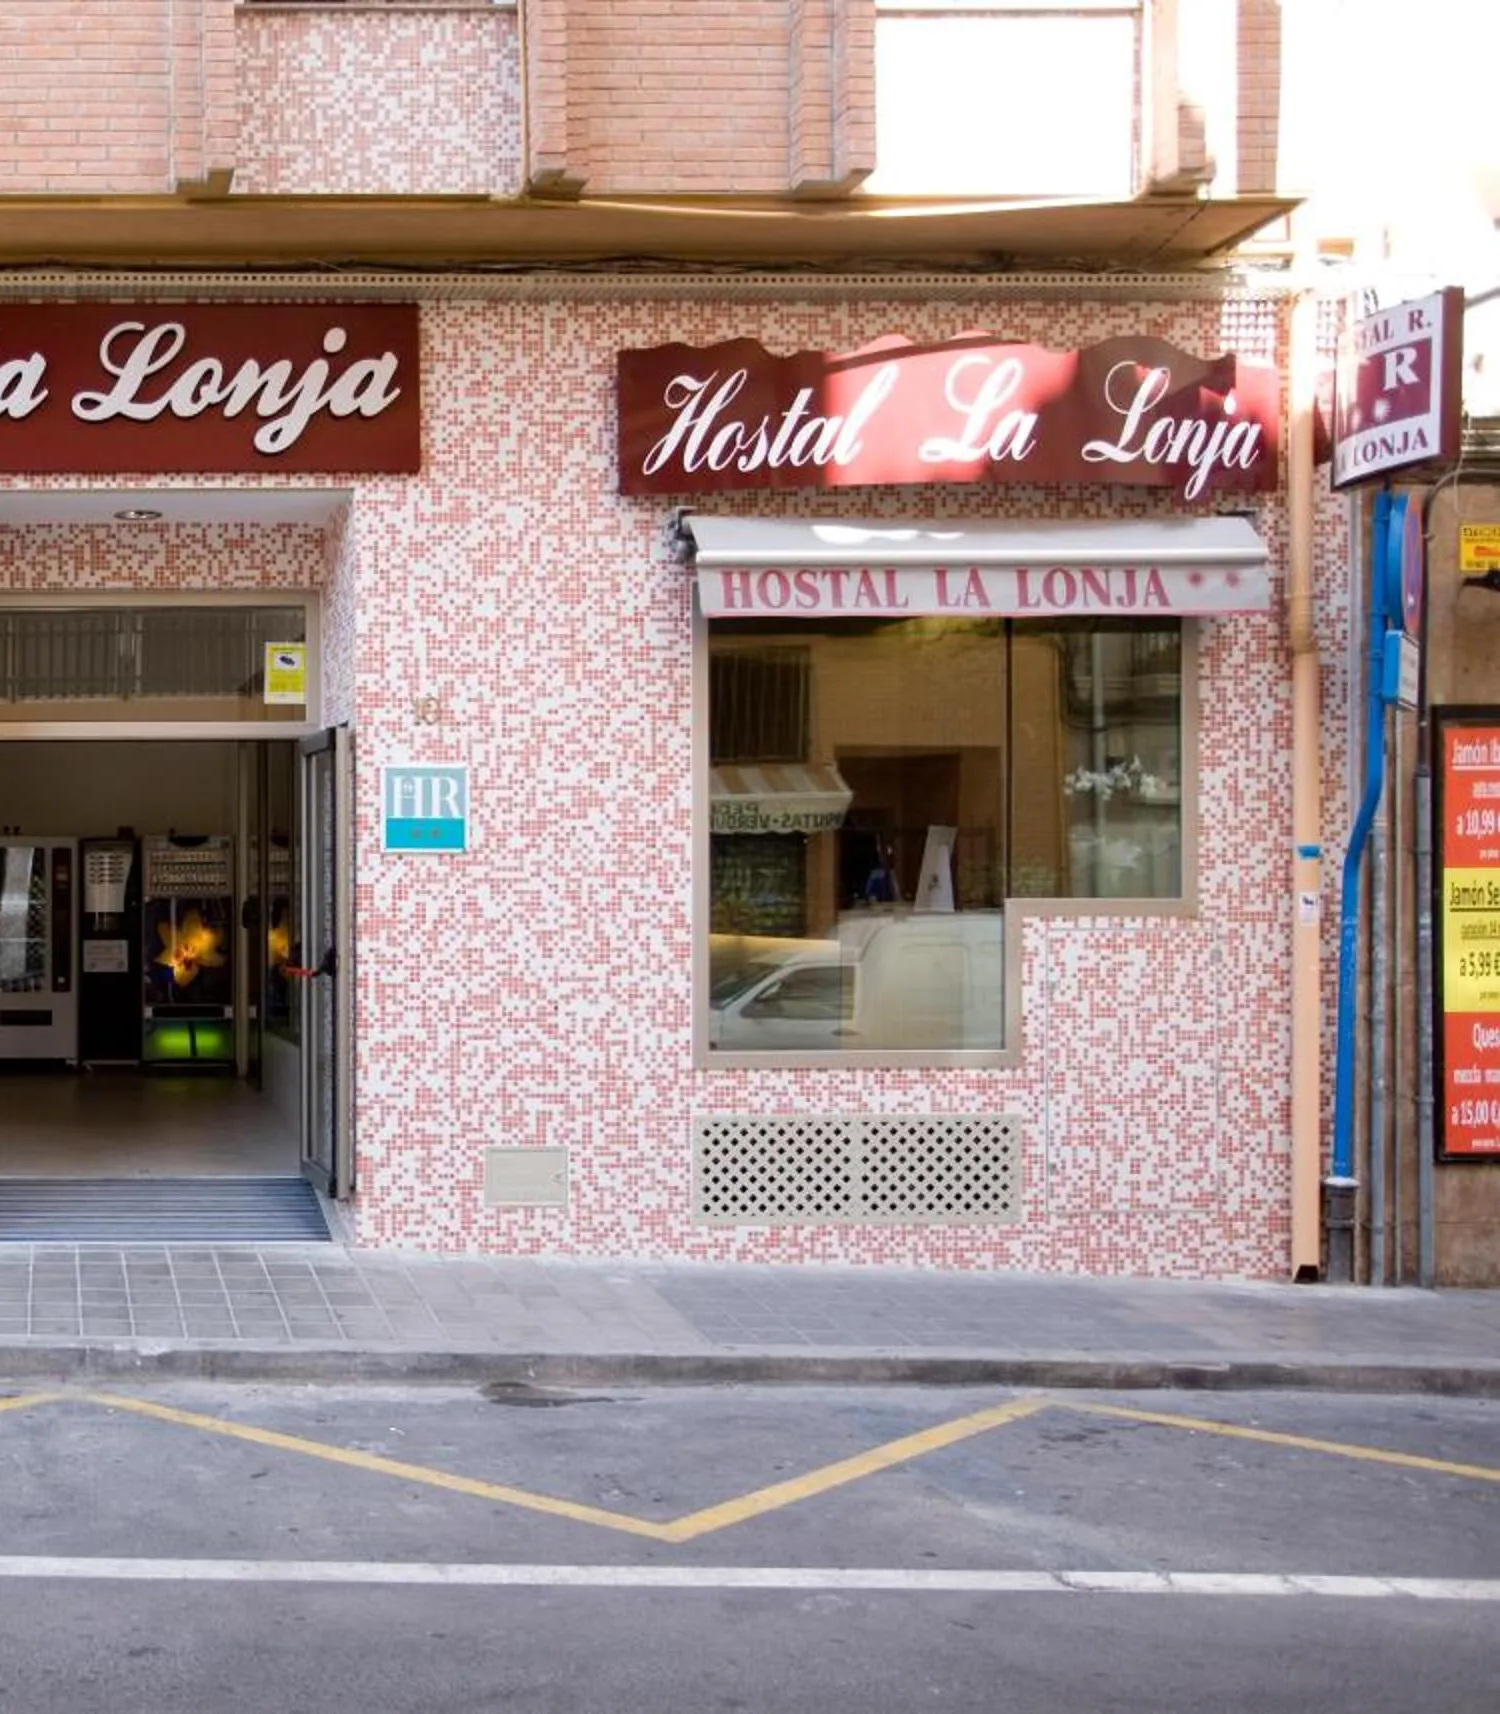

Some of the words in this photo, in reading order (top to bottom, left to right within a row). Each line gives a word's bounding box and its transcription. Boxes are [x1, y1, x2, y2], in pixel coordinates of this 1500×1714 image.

[71, 321, 401, 454] Lonja
[643, 357, 898, 475] Hostal
[917, 354, 1038, 463] La
[1081, 360, 1264, 499] Lonja
[721, 568, 909, 609] HOSTAL
[934, 568, 991, 608] LA
[1015, 567, 1171, 608] LONJA
[392, 775, 462, 819] HR
[1450, 880, 1485, 906] Jamón
